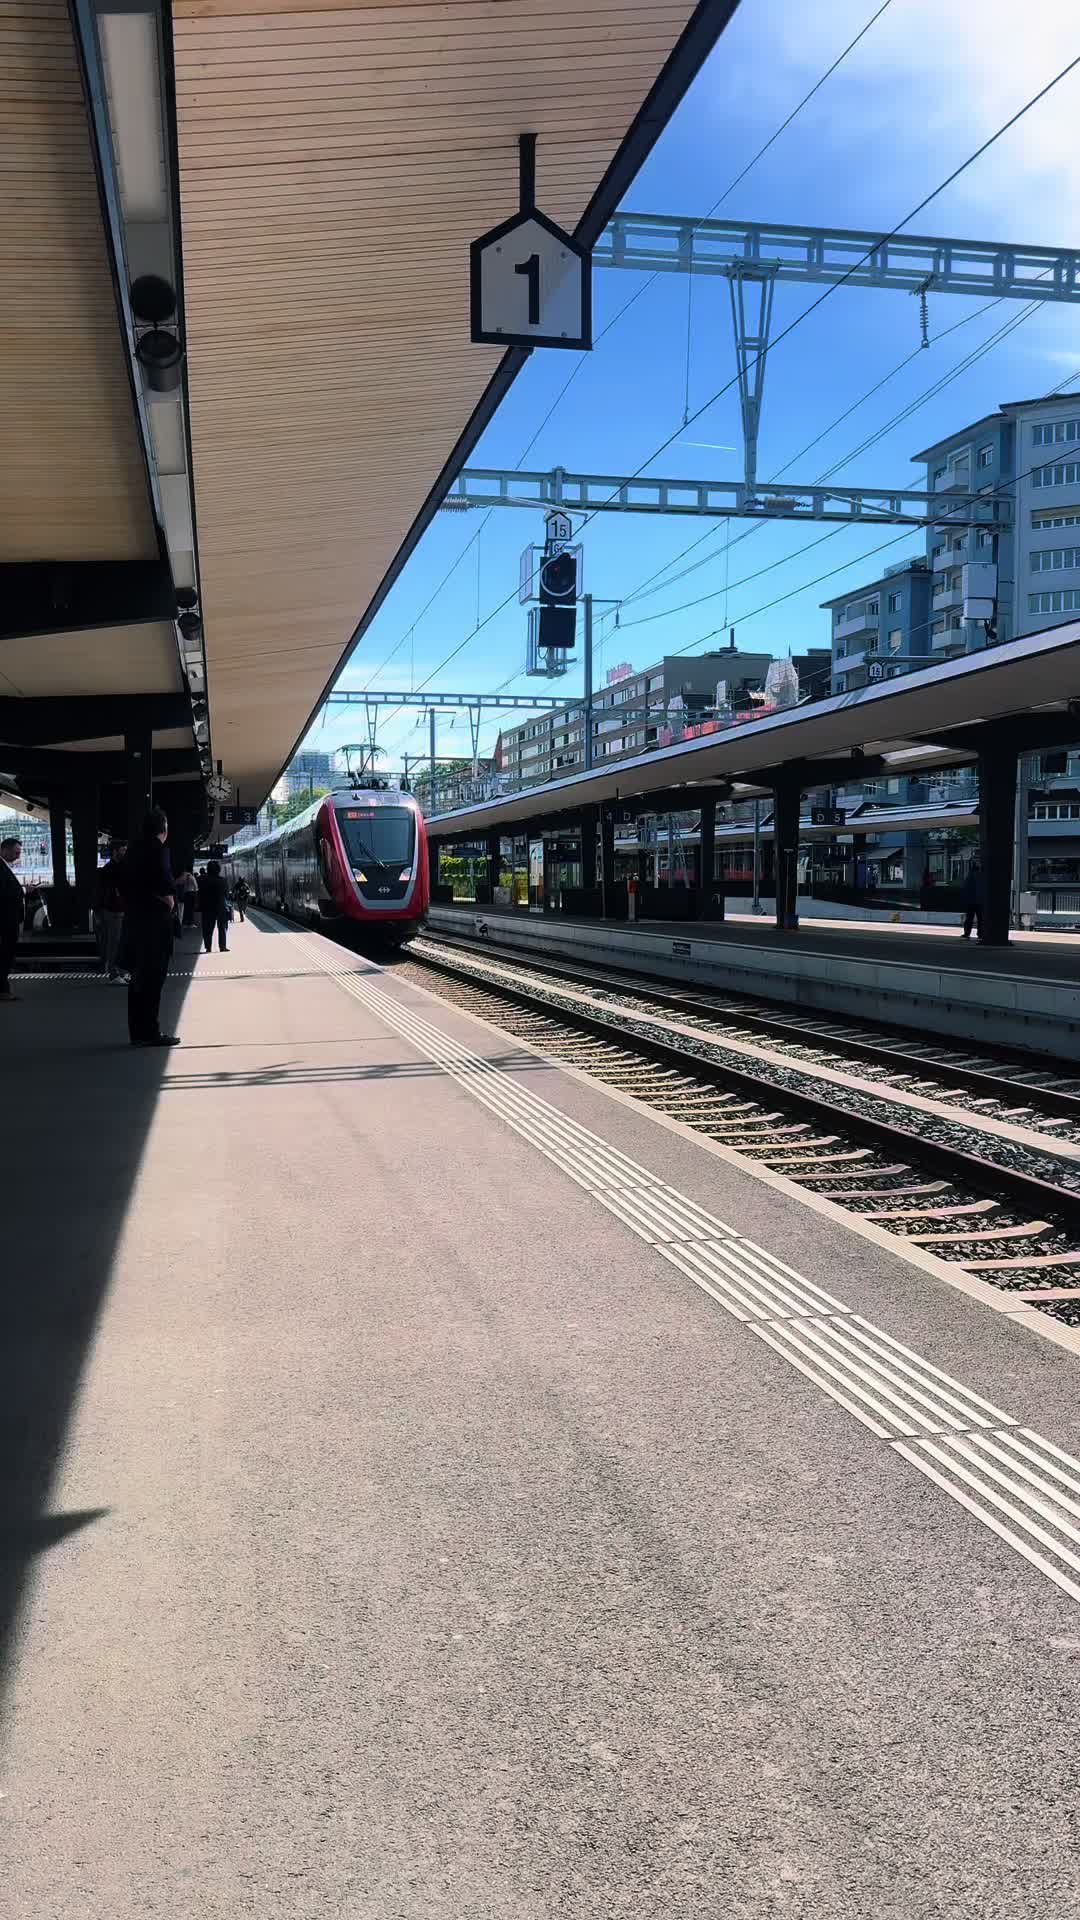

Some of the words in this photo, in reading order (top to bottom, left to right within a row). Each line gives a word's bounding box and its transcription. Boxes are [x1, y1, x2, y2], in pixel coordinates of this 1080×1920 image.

[514, 254, 540, 325] 1
[551, 520, 567, 537] 15
[225, 812, 233, 821] E
[244, 812, 251, 822] 3
[623, 812, 631, 821] D
[817, 813, 825, 823] D
[834, 813, 841, 823] 5
